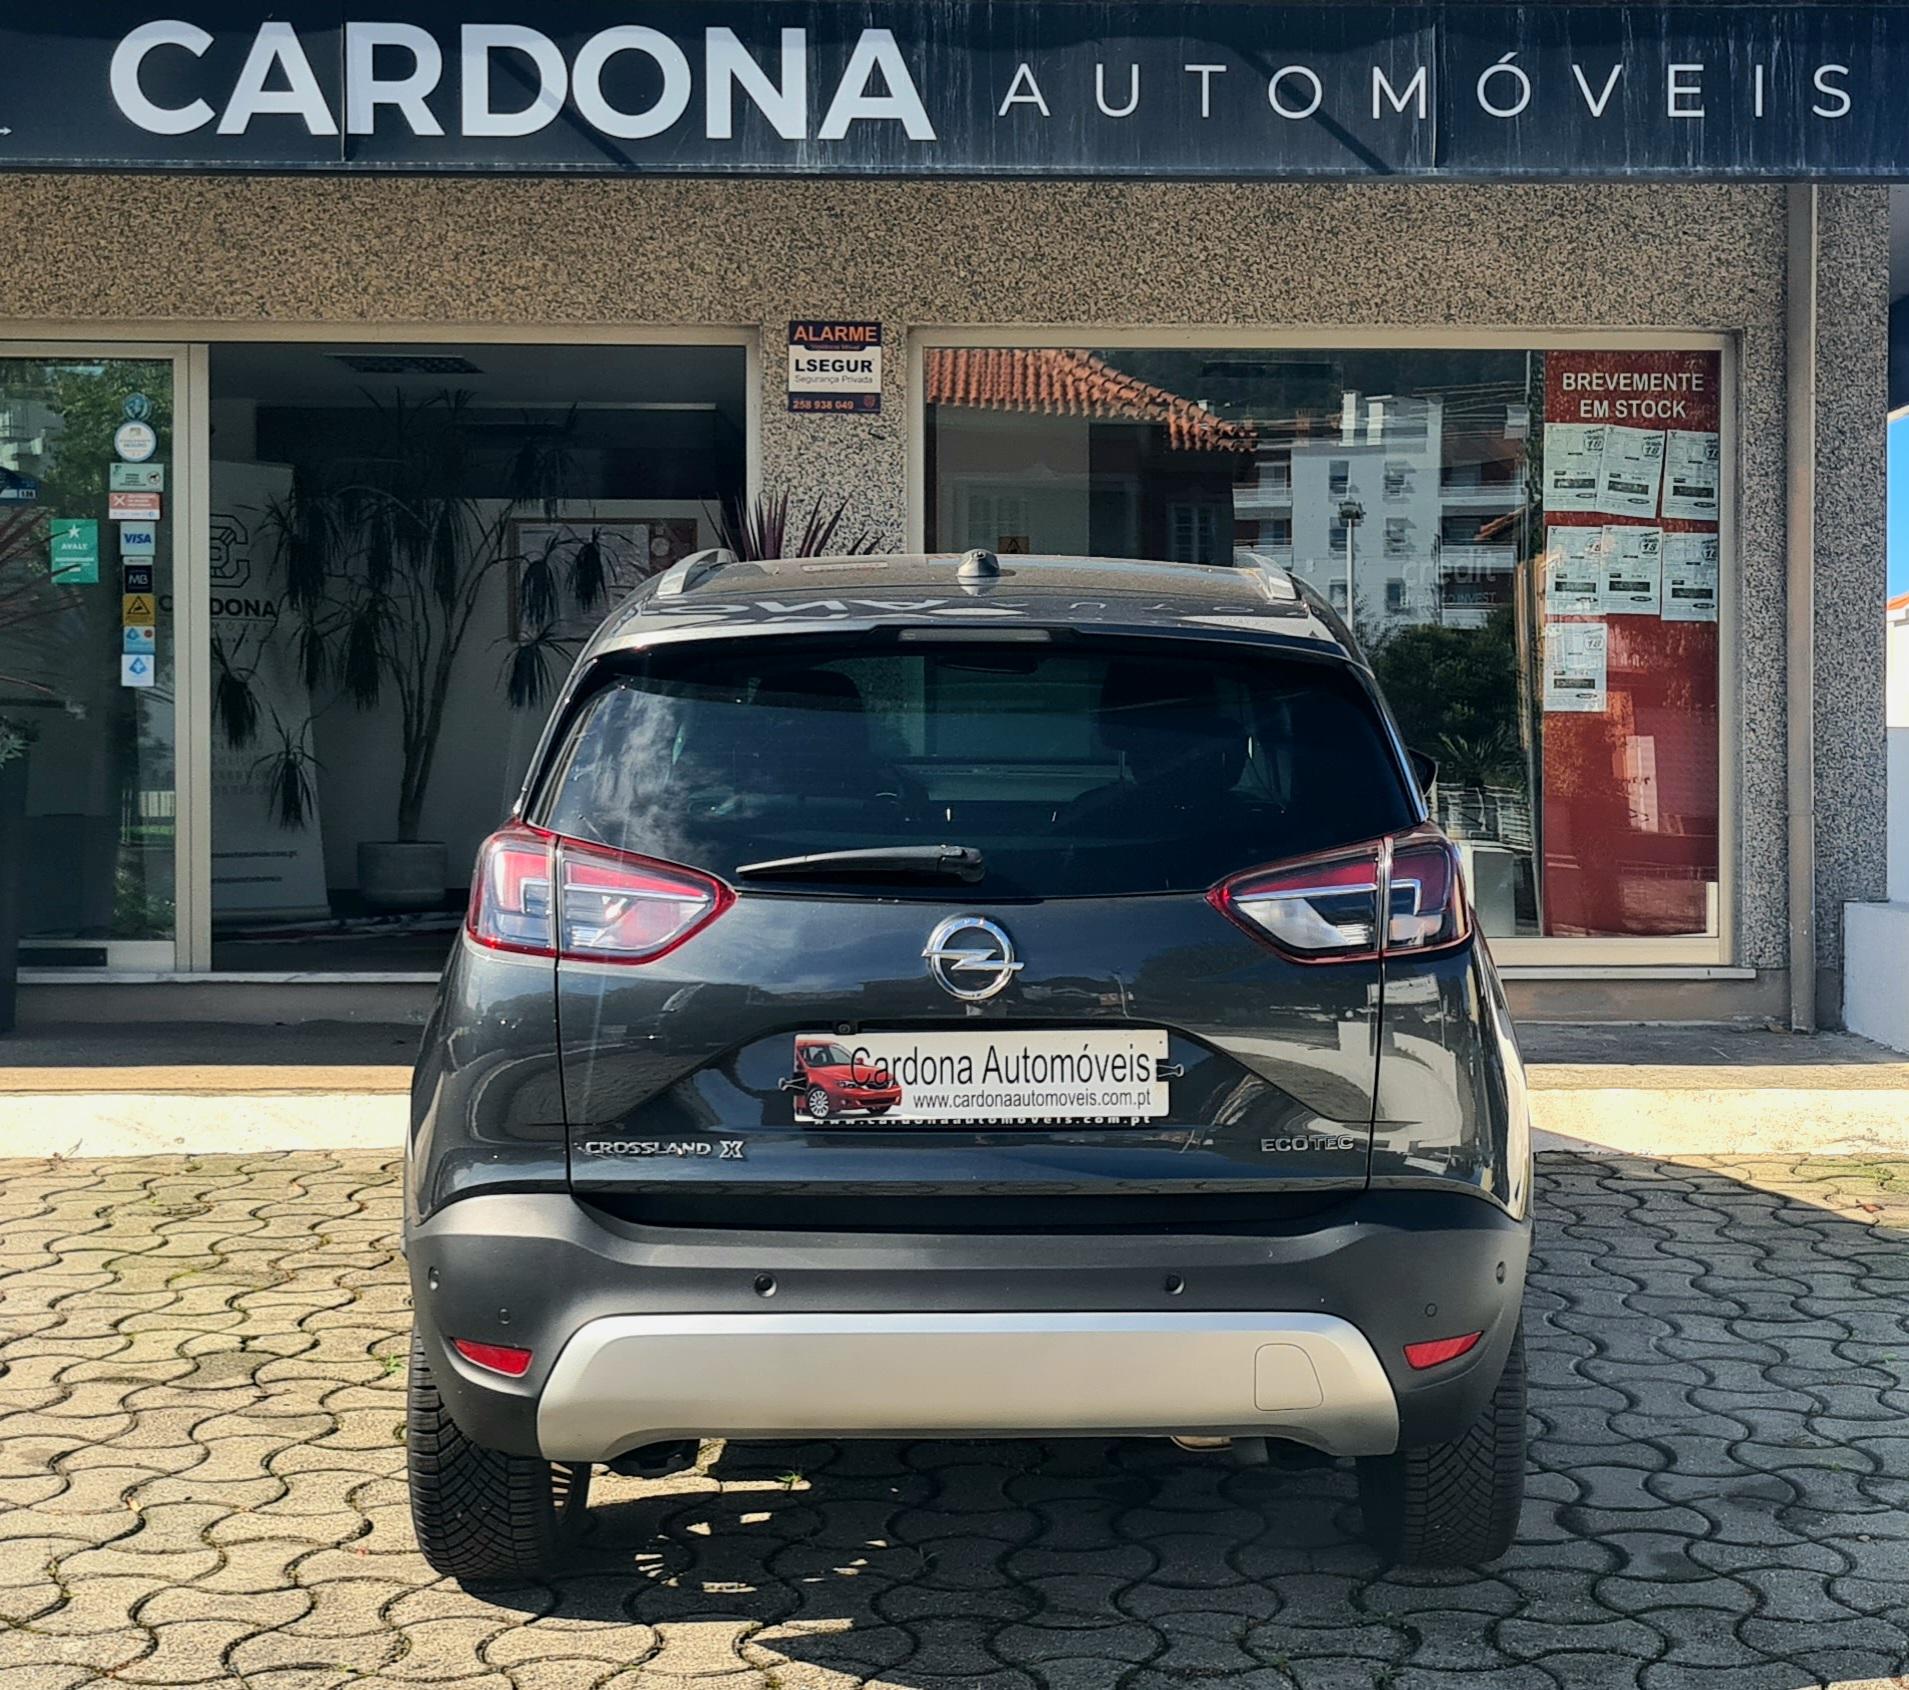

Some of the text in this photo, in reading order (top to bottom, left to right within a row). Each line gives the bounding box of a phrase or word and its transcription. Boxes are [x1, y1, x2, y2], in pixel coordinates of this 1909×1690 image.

[110, 19, 1852, 141] CARDONA AUTOMÓVEIS
[794, 325, 878, 342] ALARME
[795, 359, 873, 373] LSEGUR
[795, 374, 873, 384] Segurança Privada
[1562, 372, 1704, 392] BREVEMENTE
[1580, 400, 1686, 418] EM STOCK
[124, 533, 152, 544] VISA
[128, 574, 148, 585] MB
[159, 594, 278, 618] CDONA
[850, 1042, 1151, 1087] Cardona Automóveis
[913, 1087, 1152, 1110] www.cardonaautomoveis.com.pt
[585, 1140, 744, 1159] CROSSLAND X
[1260, 1134, 1354, 1152] ECOTEC
